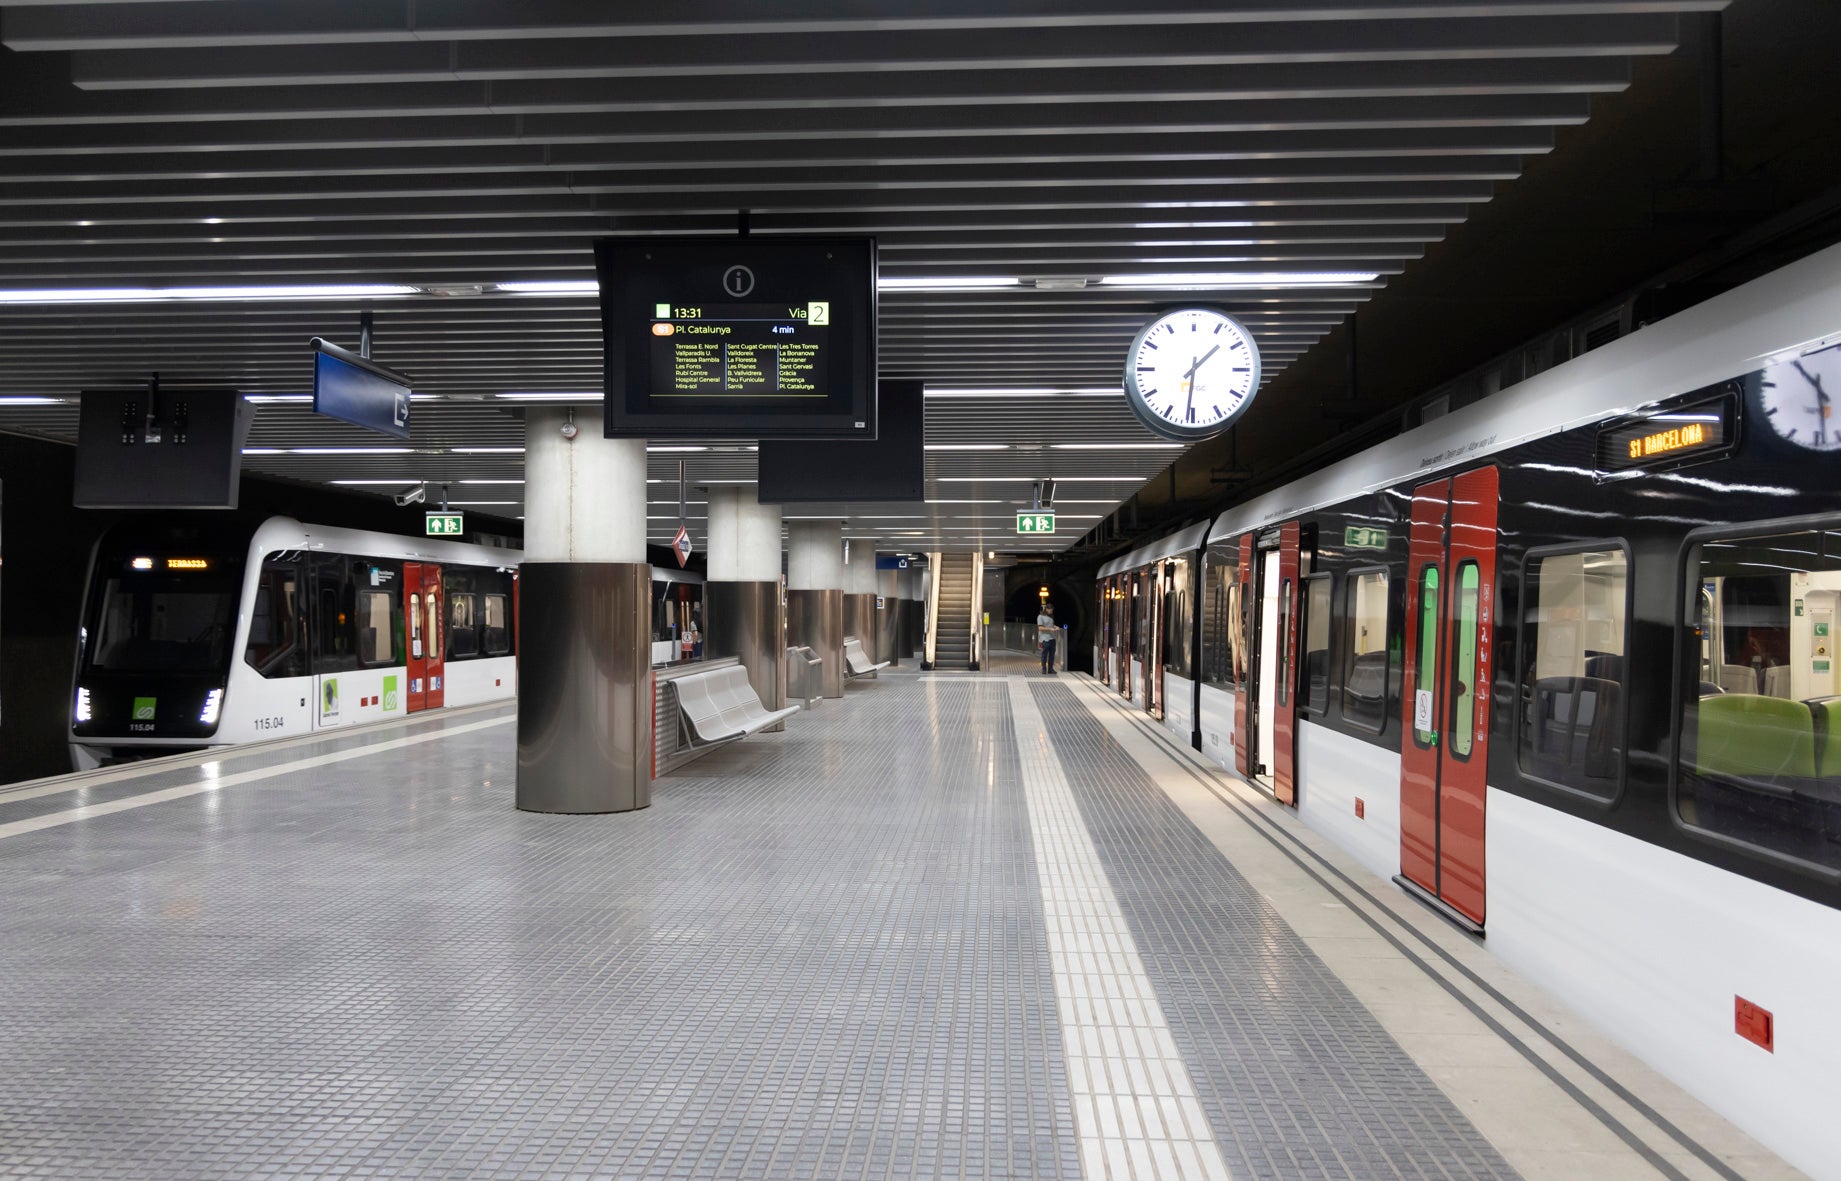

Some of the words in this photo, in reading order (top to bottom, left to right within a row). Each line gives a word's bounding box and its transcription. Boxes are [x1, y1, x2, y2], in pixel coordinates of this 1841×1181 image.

[674, 308, 701, 318] 13:31
[788, 308, 807, 318] Via
[813, 306, 824, 323] 2
[657, 325, 669, 333] S1
[675, 325, 687, 334] Pl.
[688, 325, 731, 336] Catalunya
[772, 326, 778, 334] 4
[779, 326, 794, 334] min
[787, 383, 815, 391] Catalunya
[1629, 439, 1641, 458] S1
[1644, 423, 1703, 455] BARCELONA
[130, 723, 155, 731] 115.04
[254, 716, 283, 730] 115.04
